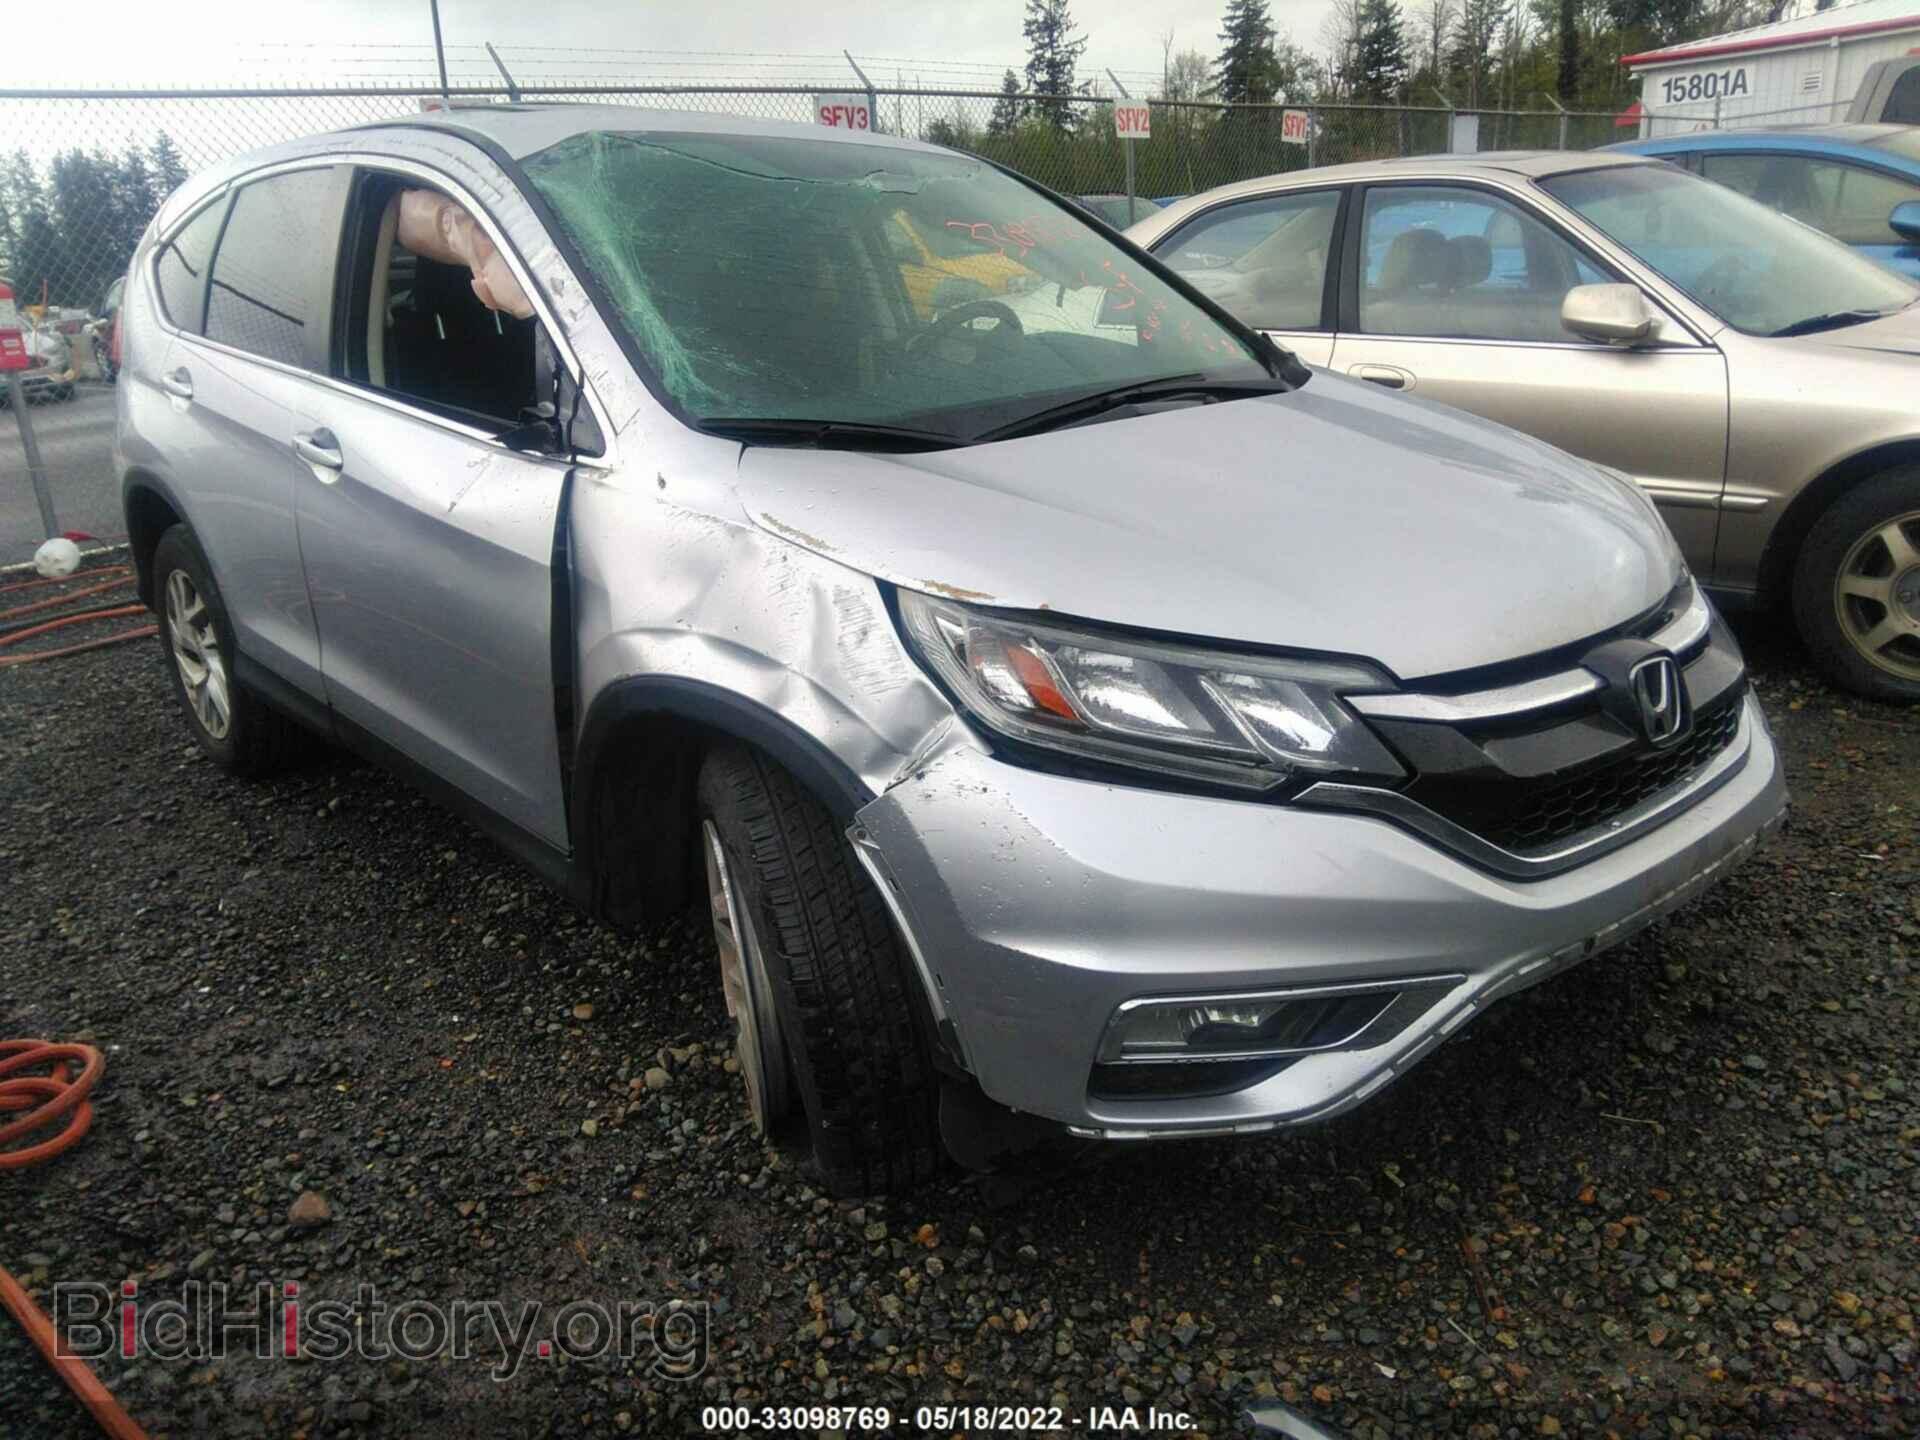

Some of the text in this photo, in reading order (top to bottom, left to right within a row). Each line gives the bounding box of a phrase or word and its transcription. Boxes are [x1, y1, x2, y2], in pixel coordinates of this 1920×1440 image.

[1662, 68, 1748, 104] 15801A
[820, 106, 868, 130] SFV3
[1117, 108, 1149, 132] SFV2
